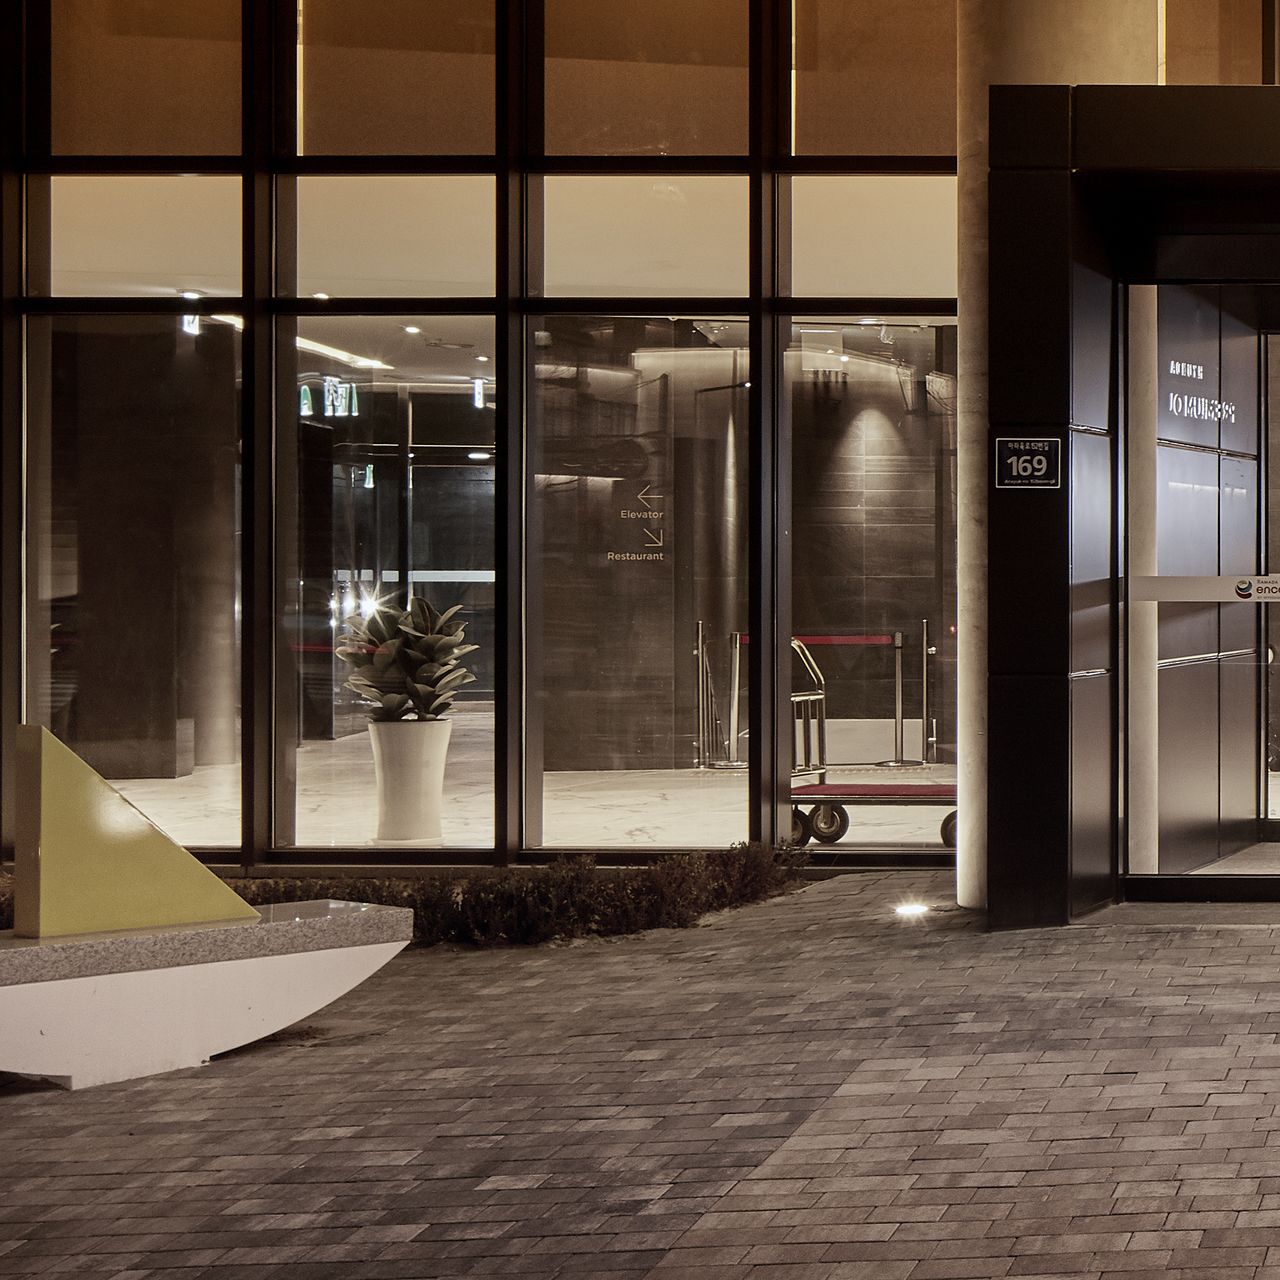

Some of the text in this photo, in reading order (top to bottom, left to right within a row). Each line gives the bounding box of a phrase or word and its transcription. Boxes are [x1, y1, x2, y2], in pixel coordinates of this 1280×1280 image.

[1007, 455, 1047, 476] 169
[620, 510, 664, 519] Elevator
[607, 551, 664, 560] Restaurant
